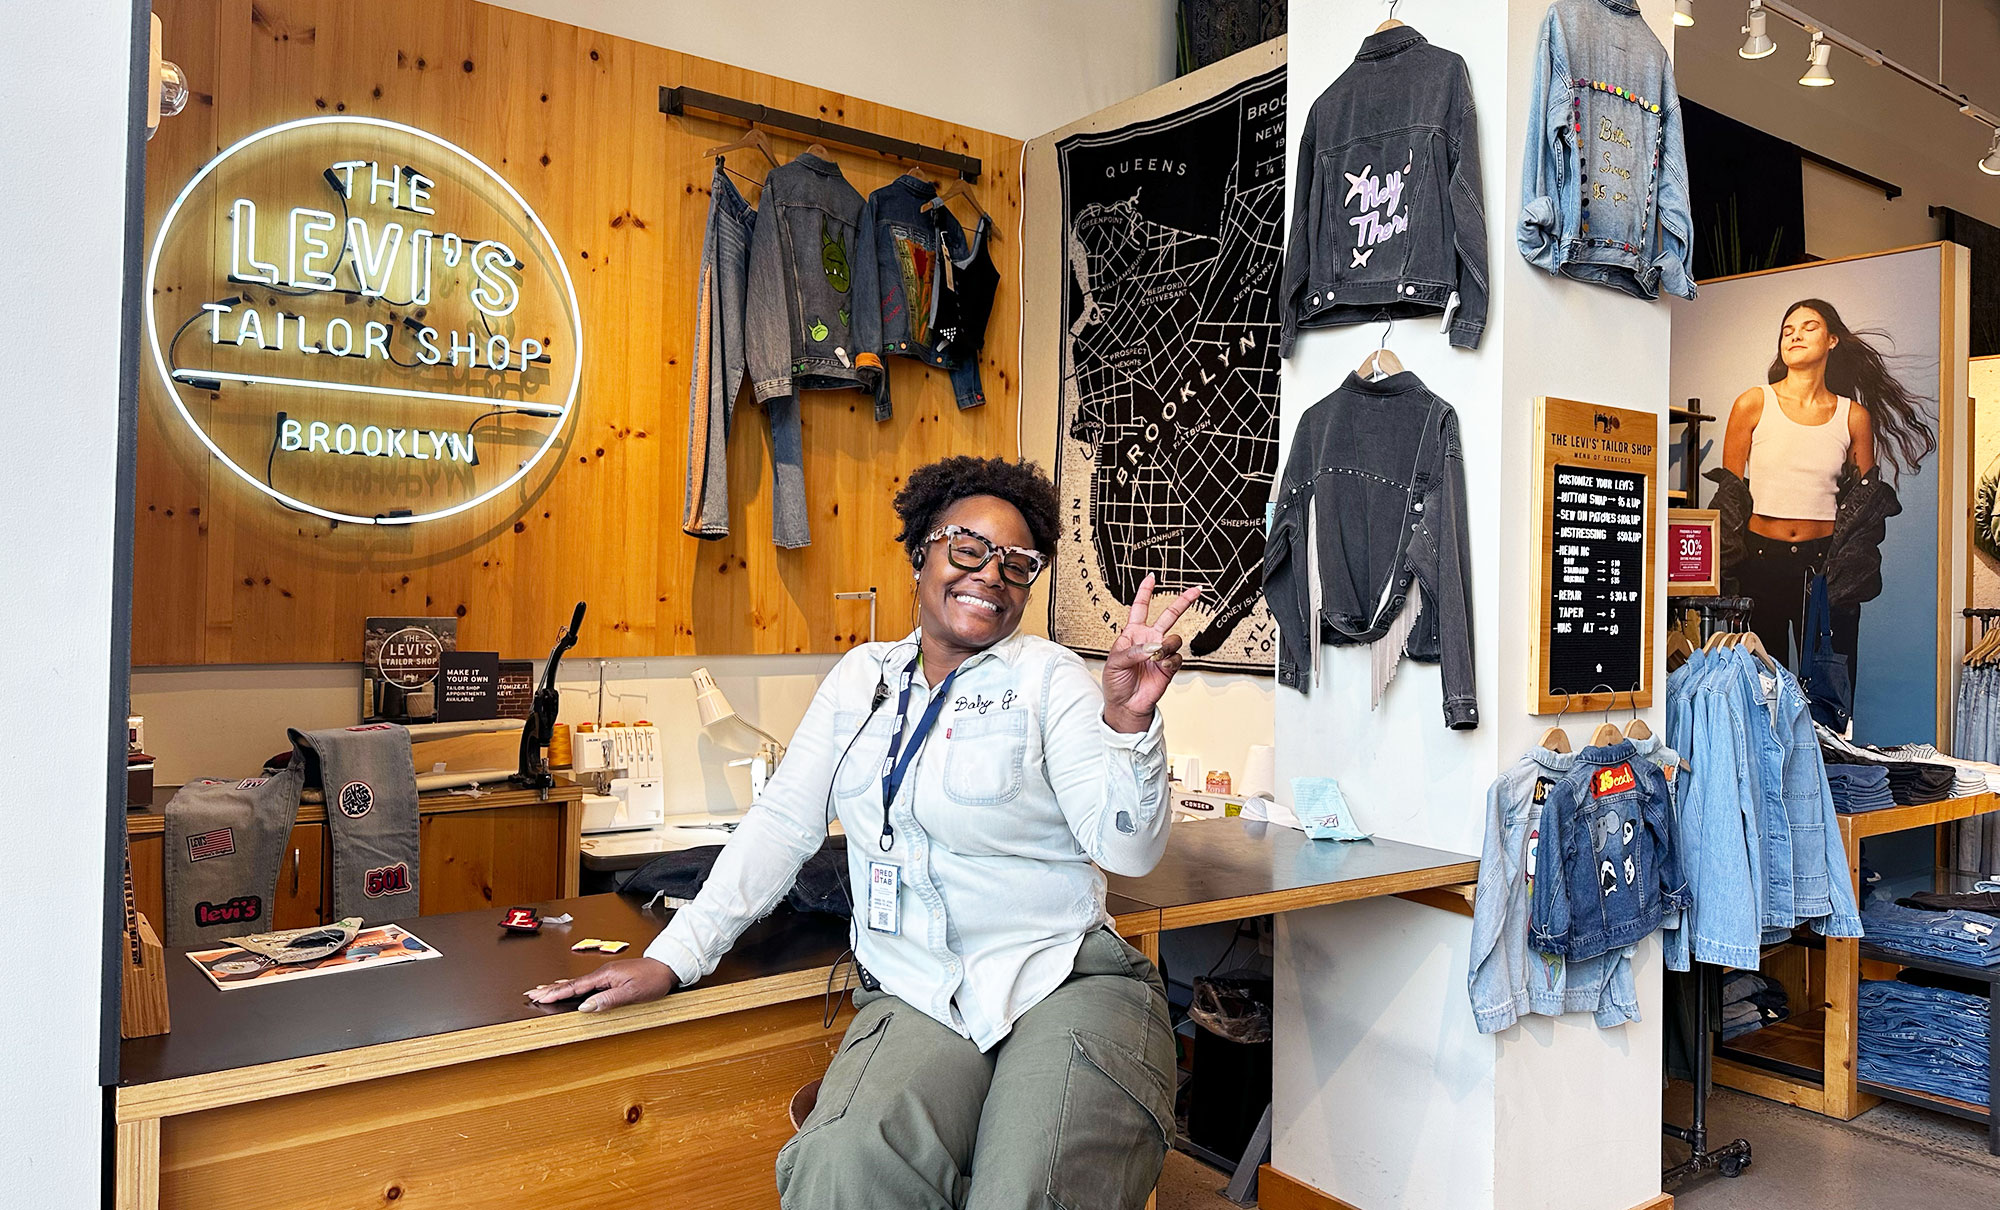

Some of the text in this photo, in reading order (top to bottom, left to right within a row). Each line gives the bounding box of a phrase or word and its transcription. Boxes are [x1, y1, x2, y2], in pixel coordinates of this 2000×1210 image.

[1256, 121, 1284, 142] NEW
[1106, 158, 1187, 178] QUEENS
[333, 160, 435, 215] THE
[1082, 216, 1123, 230] GREENPOINT
[231, 199, 519, 317] LEVI'S
[1101, 249, 1146, 292] WILLIAMSBURG
[1240, 261, 1259, 285] EAST
[1233, 261, 1274, 303] NEW YORK
[1141, 288, 1187, 307] STUYVESANT
[202, 303, 543, 373] TAILOR SHOP
[1110, 347, 1147, 361] PROSPECT
[1116, 331, 1256, 488] BROOKLYN
[280, 419, 475, 463] BROOKLYN
[1173, 418, 1211, 450] FLATBUSH
[1552, 433, 1567, 446] THE
[1602, 440, 1628, 453] TAILOR
[1632, 443, 1652, 455] SHOP
[1604, 456, 1631, 464] SERVICES
[1558, 474, 1594, 487] CUSTOMIZE
[1596, 478, 1613, 490] YOUR
[1577, 510, 1588, 522] ON
[1133, 528, 1185, 551] BENSONHURST
[1680, 539, 1702, 555] 30%
[1072, 498, 1124, 635] NEW YORK BA
[1629, 592, 1638, 601] UP
[1216, 603, 1242, 628] CONEY
[1559, 607, 1615, 618] TAPER 5
[1583, 622, 1595, 633] ALT
[390, 643, 433, 656] LEVI'S
[386, 657, 437, 666] TAILOR SHOP
[369, 866, 407, 894] 501
[880, 869, 893, 877] RED
[880, 877, 893, 885] TAB
[200, 901, 257, 923] levi's
